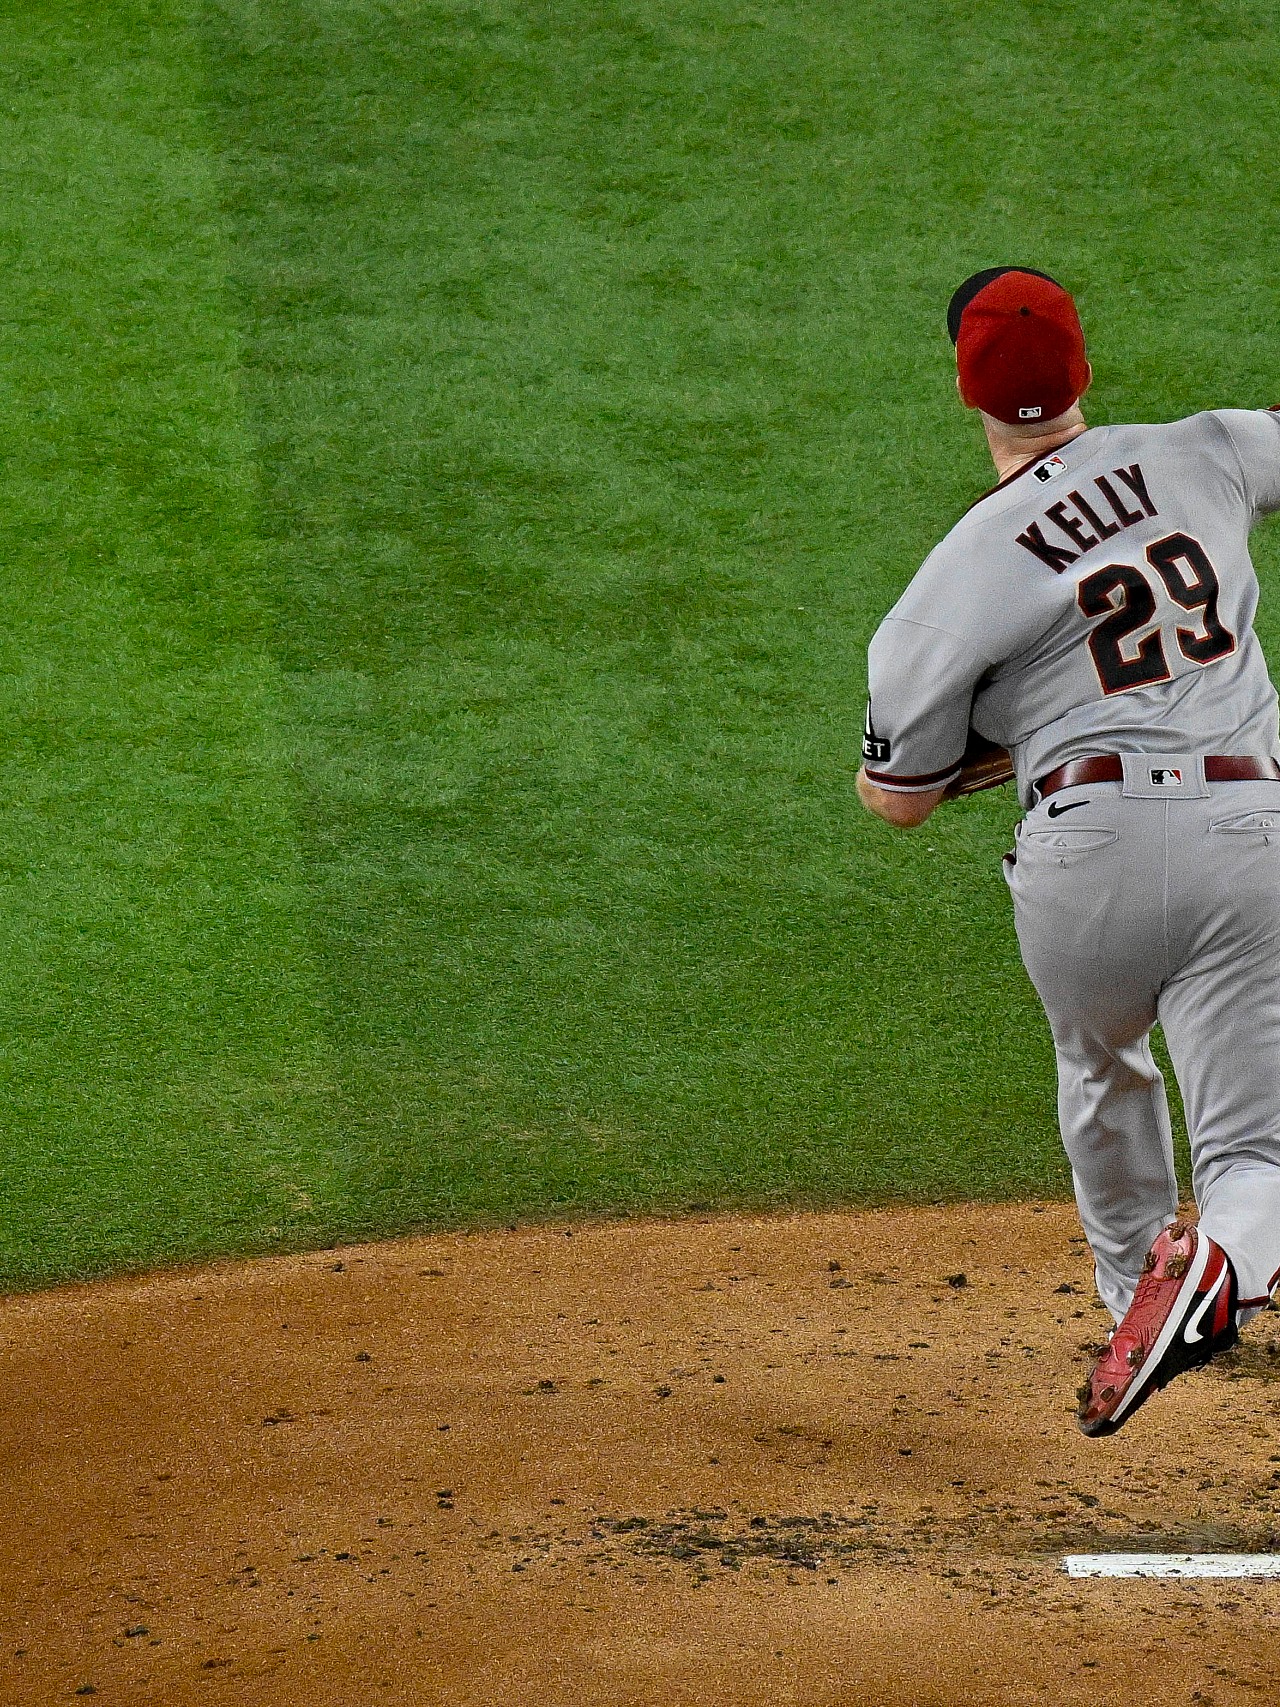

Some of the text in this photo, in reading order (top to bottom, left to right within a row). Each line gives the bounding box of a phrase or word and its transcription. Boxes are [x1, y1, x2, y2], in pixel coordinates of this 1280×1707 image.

[1015, 463, 1159, 575] KELLY
[1076, 531, 1237, 695] 29
[863, 735, 885, 757] ET
